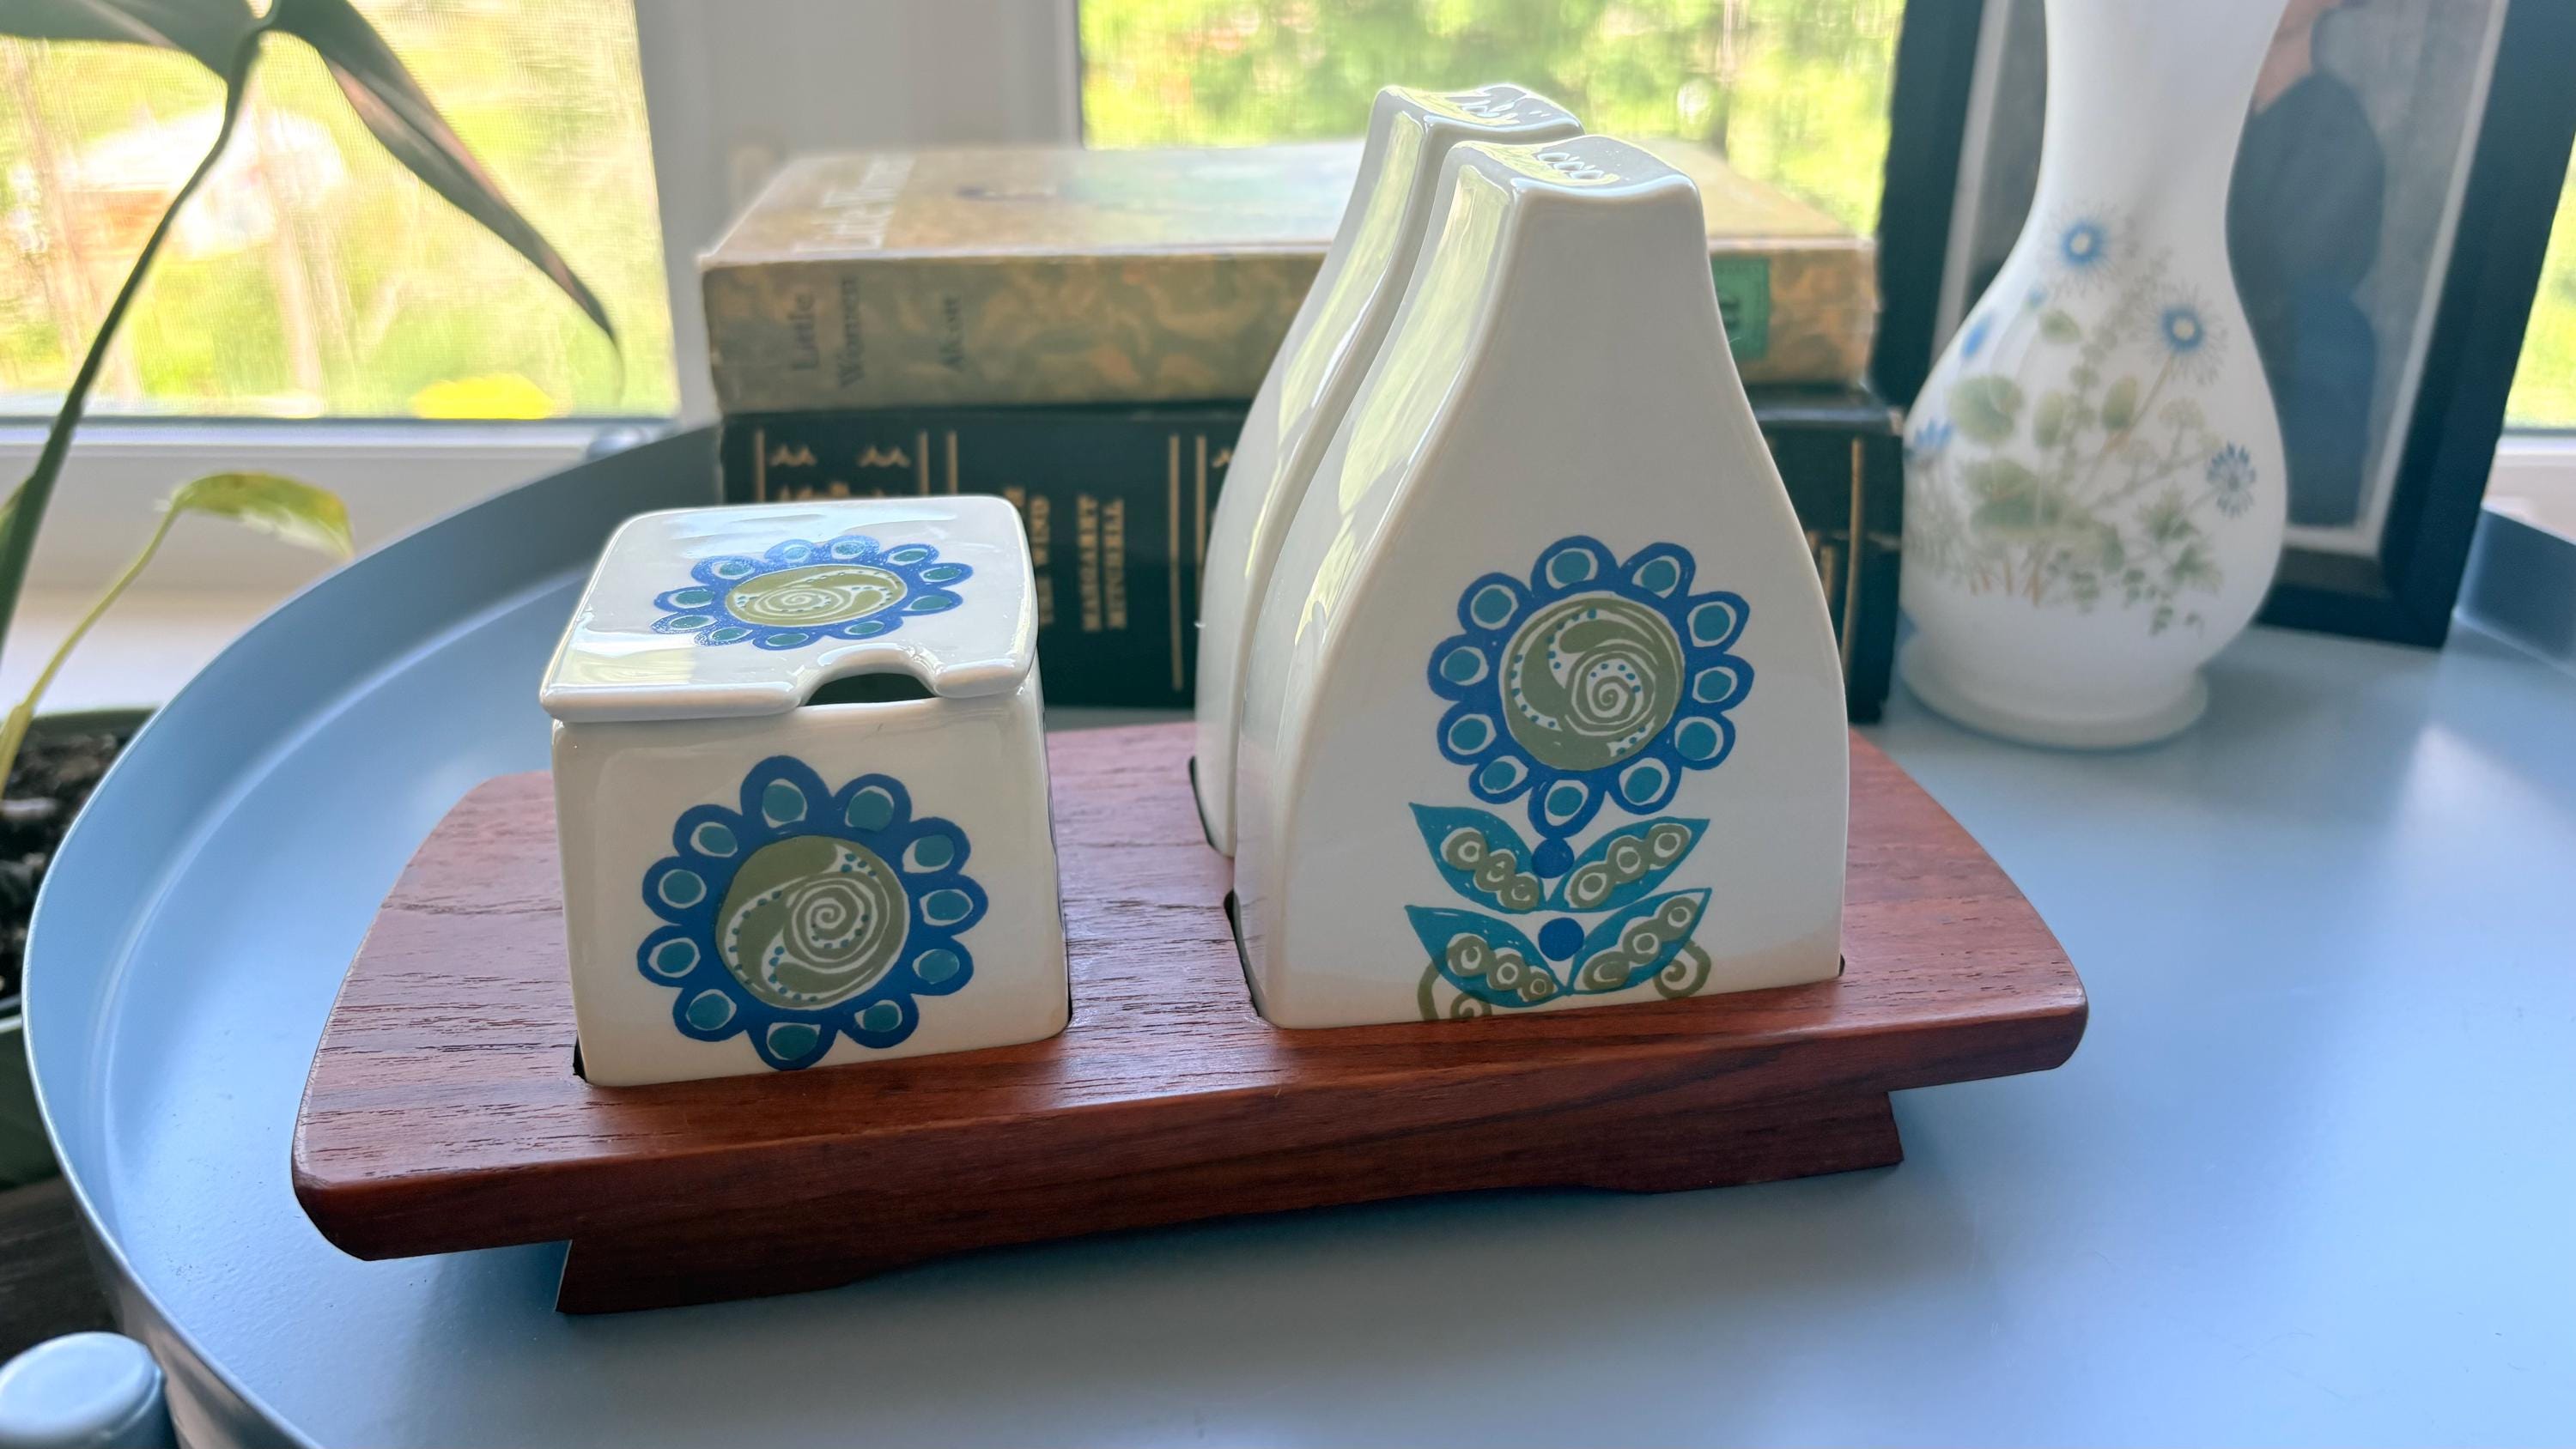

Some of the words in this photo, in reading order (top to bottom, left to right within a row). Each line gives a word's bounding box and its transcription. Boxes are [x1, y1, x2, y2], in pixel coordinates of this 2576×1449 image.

[788, 295, 818, 371] Little
[836, 276, 865, 386] Women
[1078, 494, 1101, 631] MARGARET
[1103, 499, 1127, 628] MITCHELL
